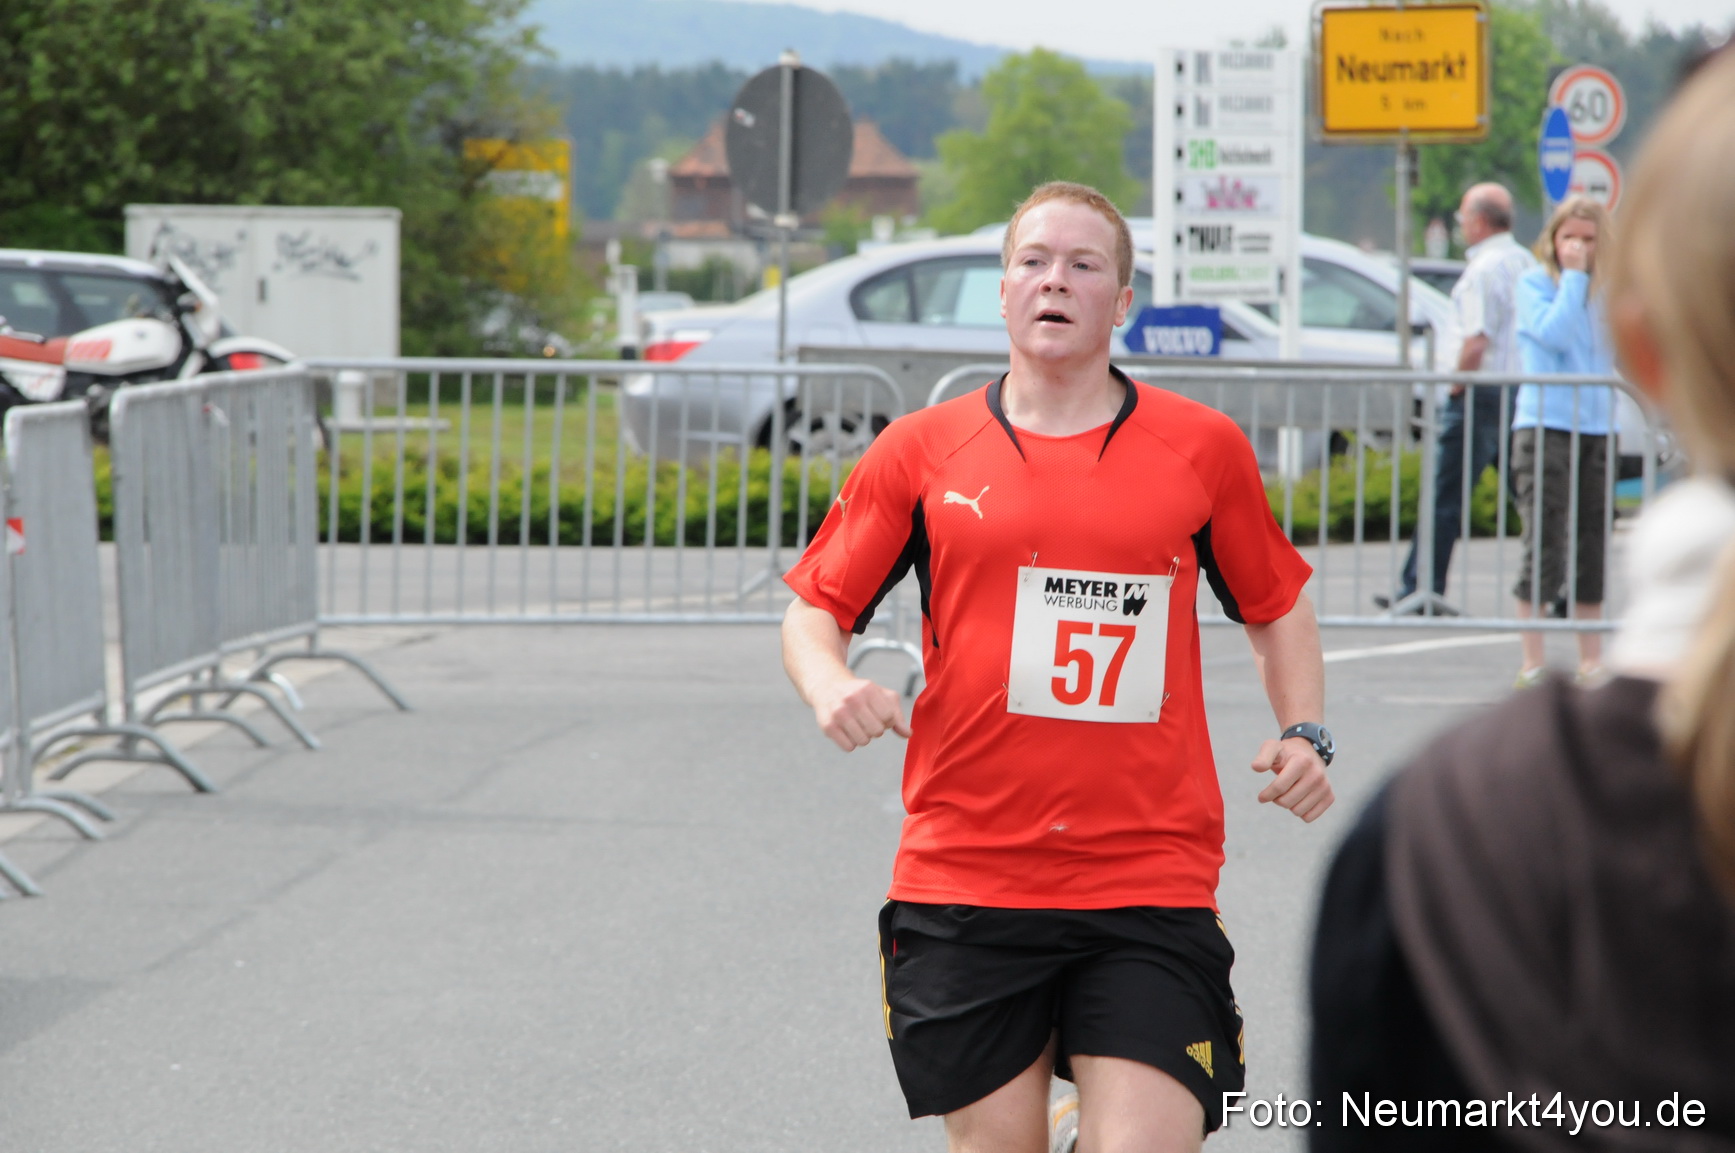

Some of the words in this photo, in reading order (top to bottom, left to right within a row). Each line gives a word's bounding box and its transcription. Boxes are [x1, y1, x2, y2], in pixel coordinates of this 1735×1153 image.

[1379, 27, 1425, 42] Nach
[1336, 53, 1468, 83] Neumarkt
[1380, 96, 1391, 111] 5
[1403, 95, 1427, 111] km
[1569, 89, 1608, 123] 60
[1142, 325, 1214, 355] VOLVO
[1044, 577, 1118, 598] MEYER
[1044, 594, 1118, 612] WERBUNG
[1050, 619, 1137, 707] 57
[1186, 1044, 1214, 1079] adidas
